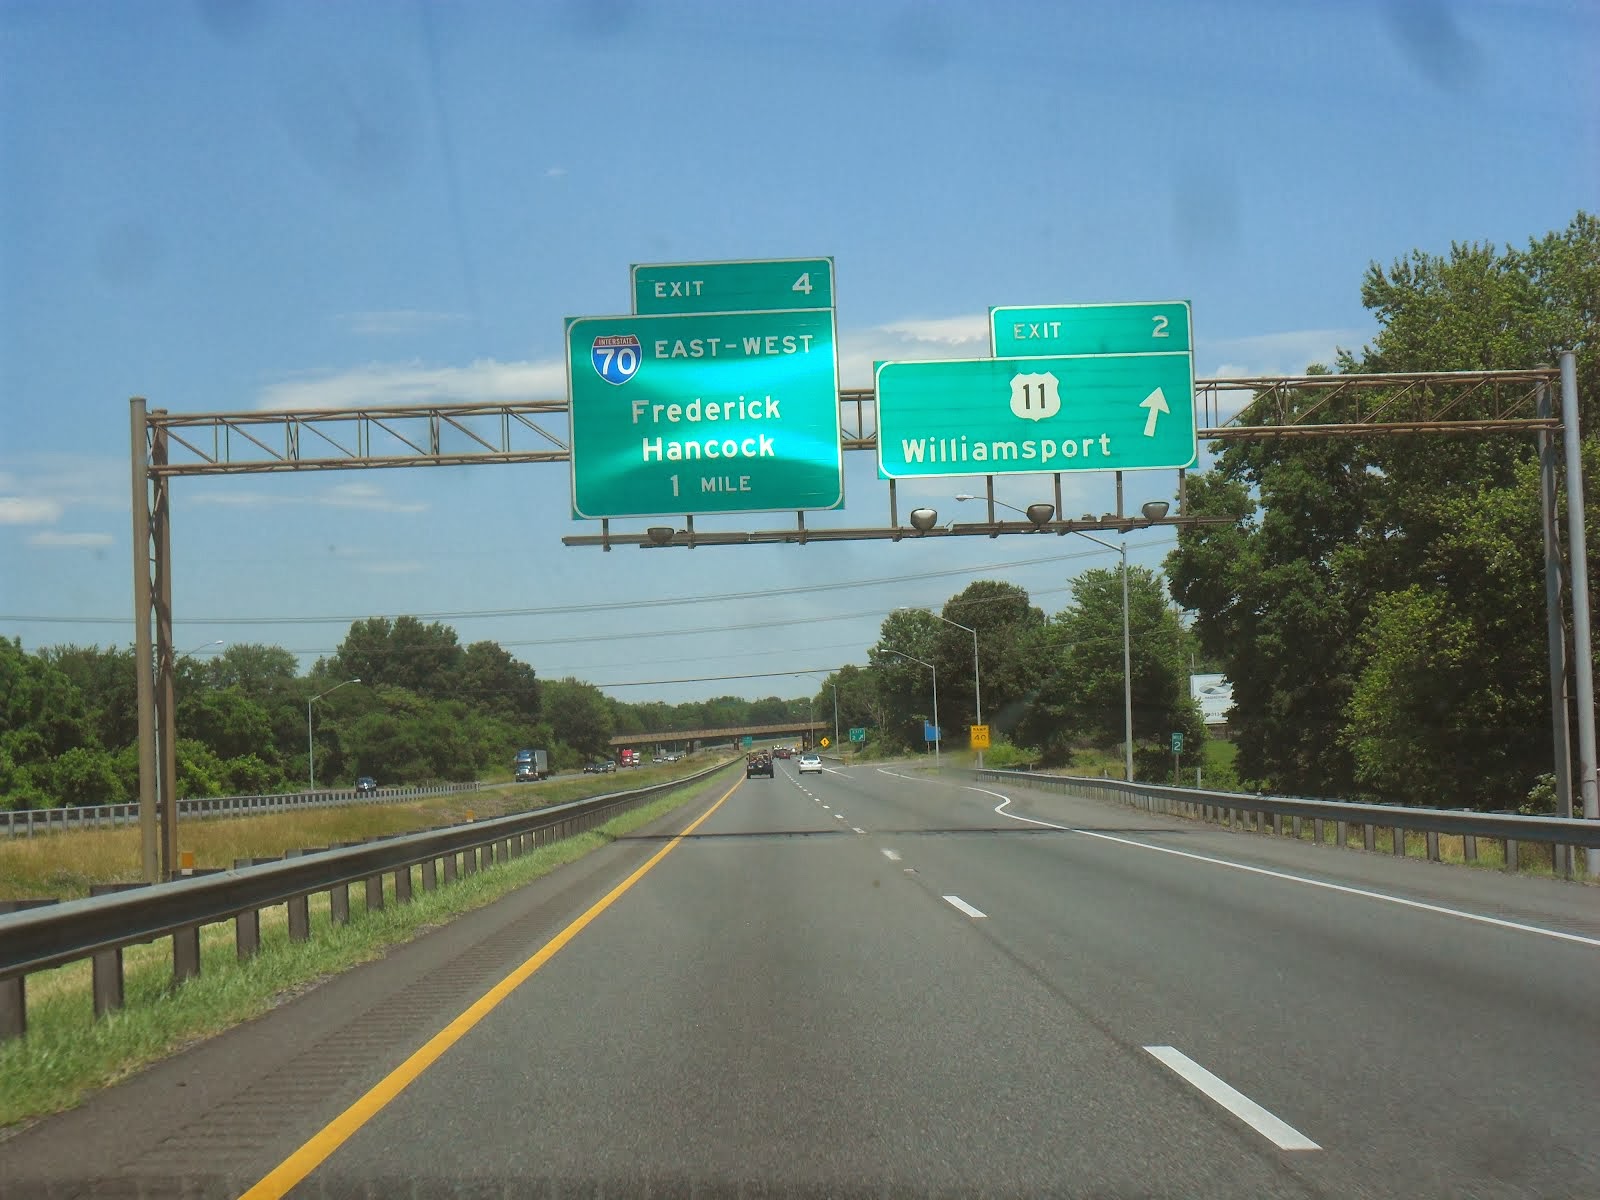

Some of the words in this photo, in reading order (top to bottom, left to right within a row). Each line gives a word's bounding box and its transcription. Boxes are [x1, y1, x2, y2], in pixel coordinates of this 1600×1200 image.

[654, 280, 704, 298] EXIT
[792, 272, 813, 295] 4
[1014, 321, 1062, 341] EXIT
[1151, 315, 1170, 338] 2
[598, 337, 633, 346] INTERSTATE
[596, 348, 636, 375] 70
[631, 394, 781, 424] Frederick
[1022, 382, 1047, 410] 11
[642, 433, 775, 462] Hancock
[901, 432, 1111, 463] Williamsport
[669, 474, 680, 497] 1
[701, 475, 752, 492] MILE
[1174, 741, 1181, 751] 2
